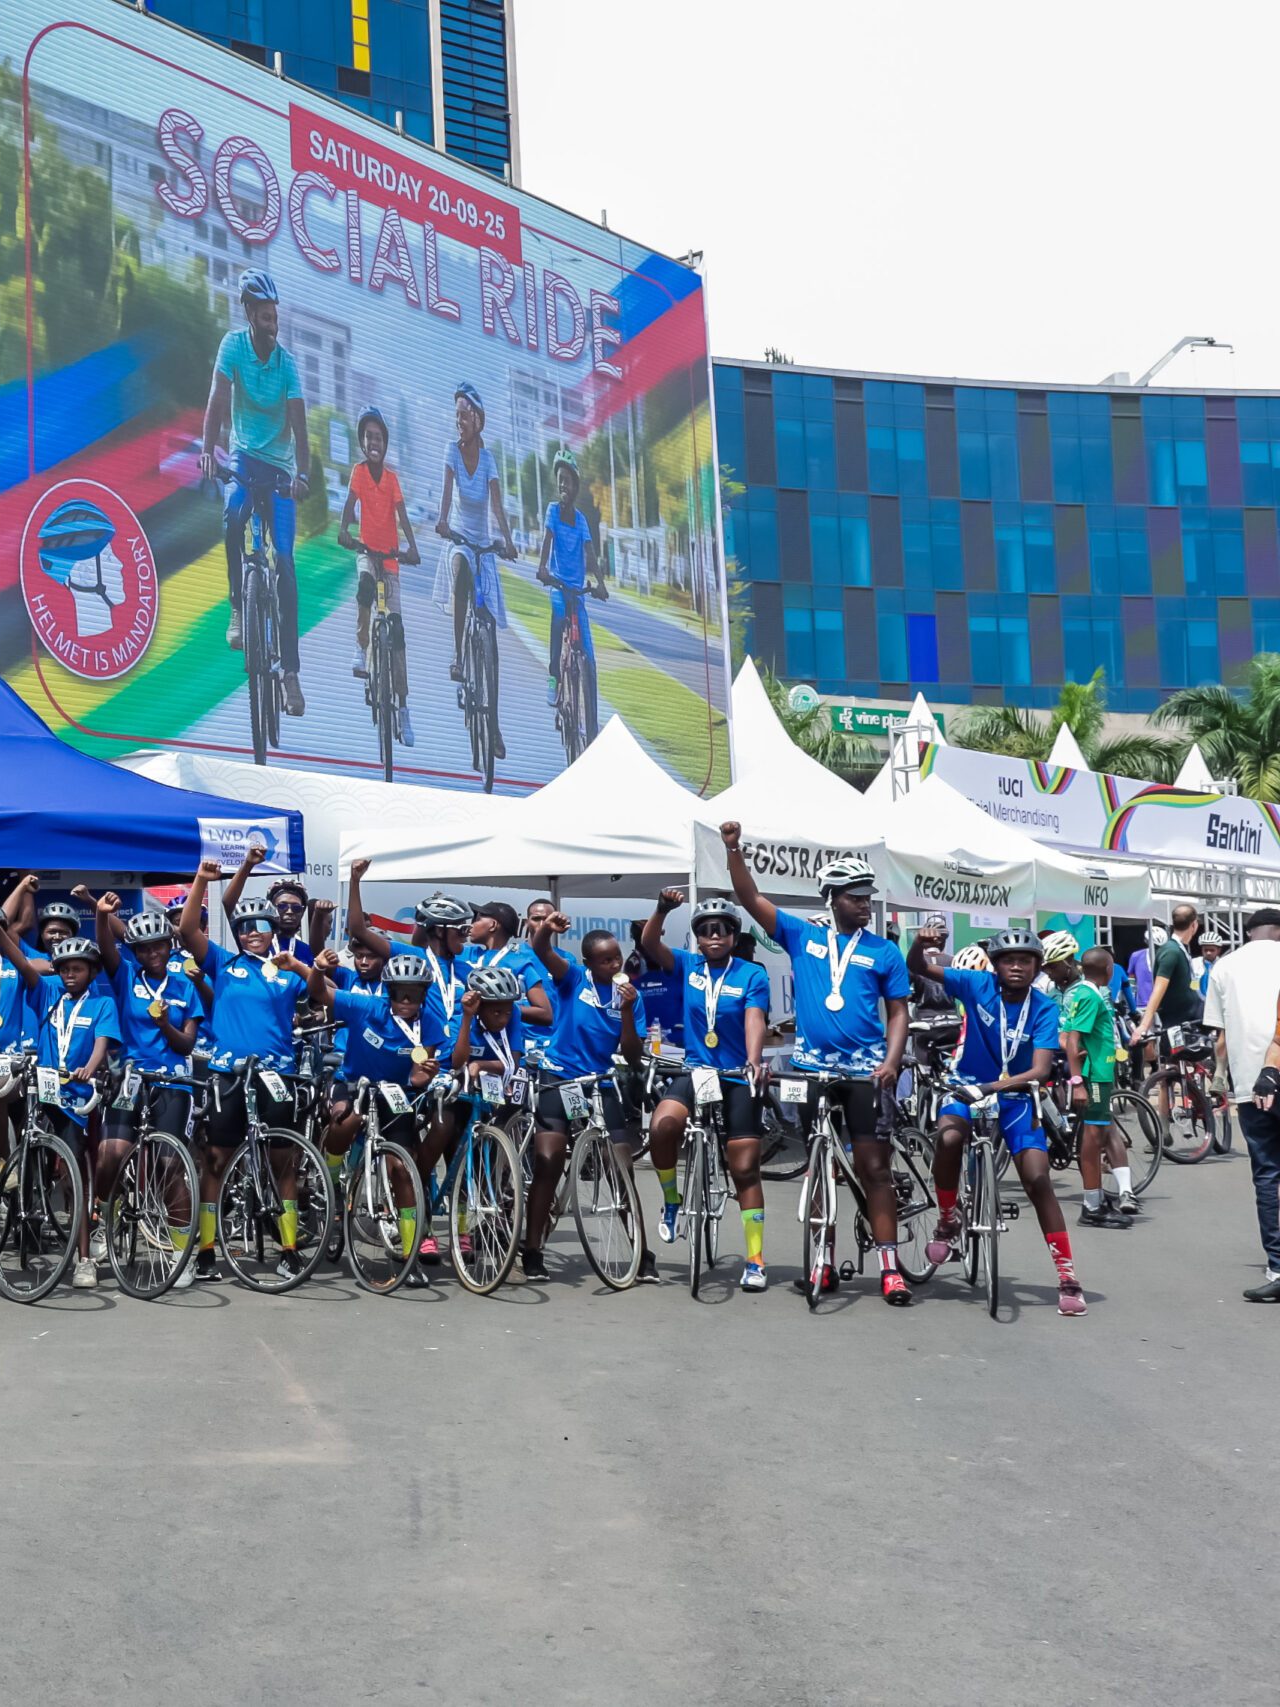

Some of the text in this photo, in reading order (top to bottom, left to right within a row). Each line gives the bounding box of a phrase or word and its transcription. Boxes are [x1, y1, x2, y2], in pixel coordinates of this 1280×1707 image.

[308, 129, 507, 241] SATURDAY 20-09-25
[155, 106, 625, 381] SOCIAL RIDE
[32, 535, 152, 671] HELMET IS MANDATORY
[855, 711, 880, 725] vine
[1002, 777, 1023, 798] UCI
[992, 801, 1059, 834] Merchandising
[208, 829, 244, 842] LWD
[1206, 813, 1262, 855] Santini
[914, 874, 1012, 908] REGISTRATION
[1084, 885, 1108, 907] INFO
[43, 1080, 56, 1091] 164
[567, 1096, 581, 1105] 153
